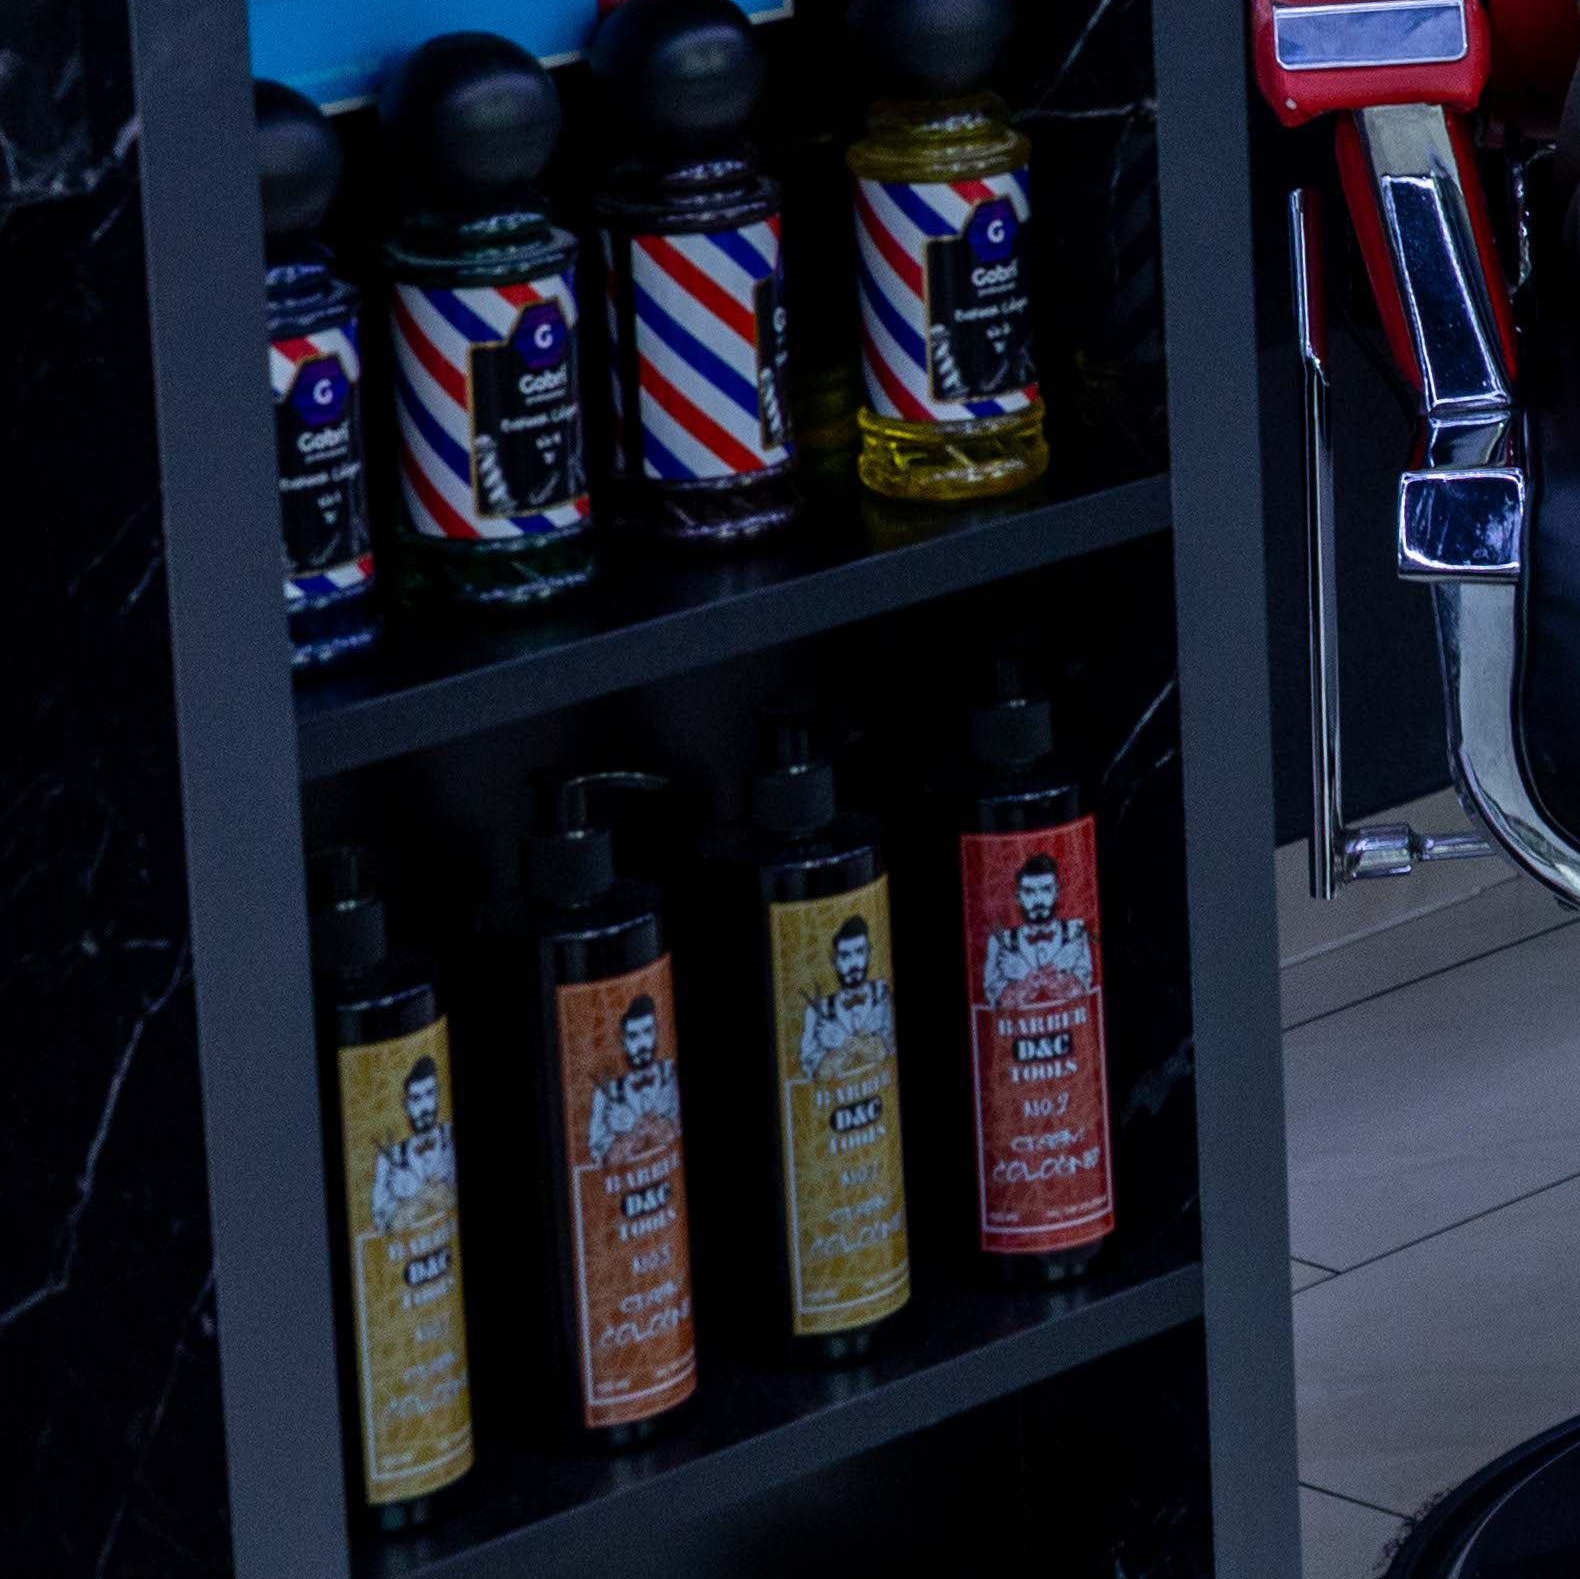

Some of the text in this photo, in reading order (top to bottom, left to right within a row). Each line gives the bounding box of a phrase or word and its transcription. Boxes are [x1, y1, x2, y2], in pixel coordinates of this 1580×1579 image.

[986, 219, 1006, 244] G
[533, 323, 555, 350] G
[312, 377, 335, 406] G
[997, 1006, 1087, 1036] BARBER
[1015, 1034, 1070, 1061] D&C
[1009, 1060, 1079, 1083] TOOLS
